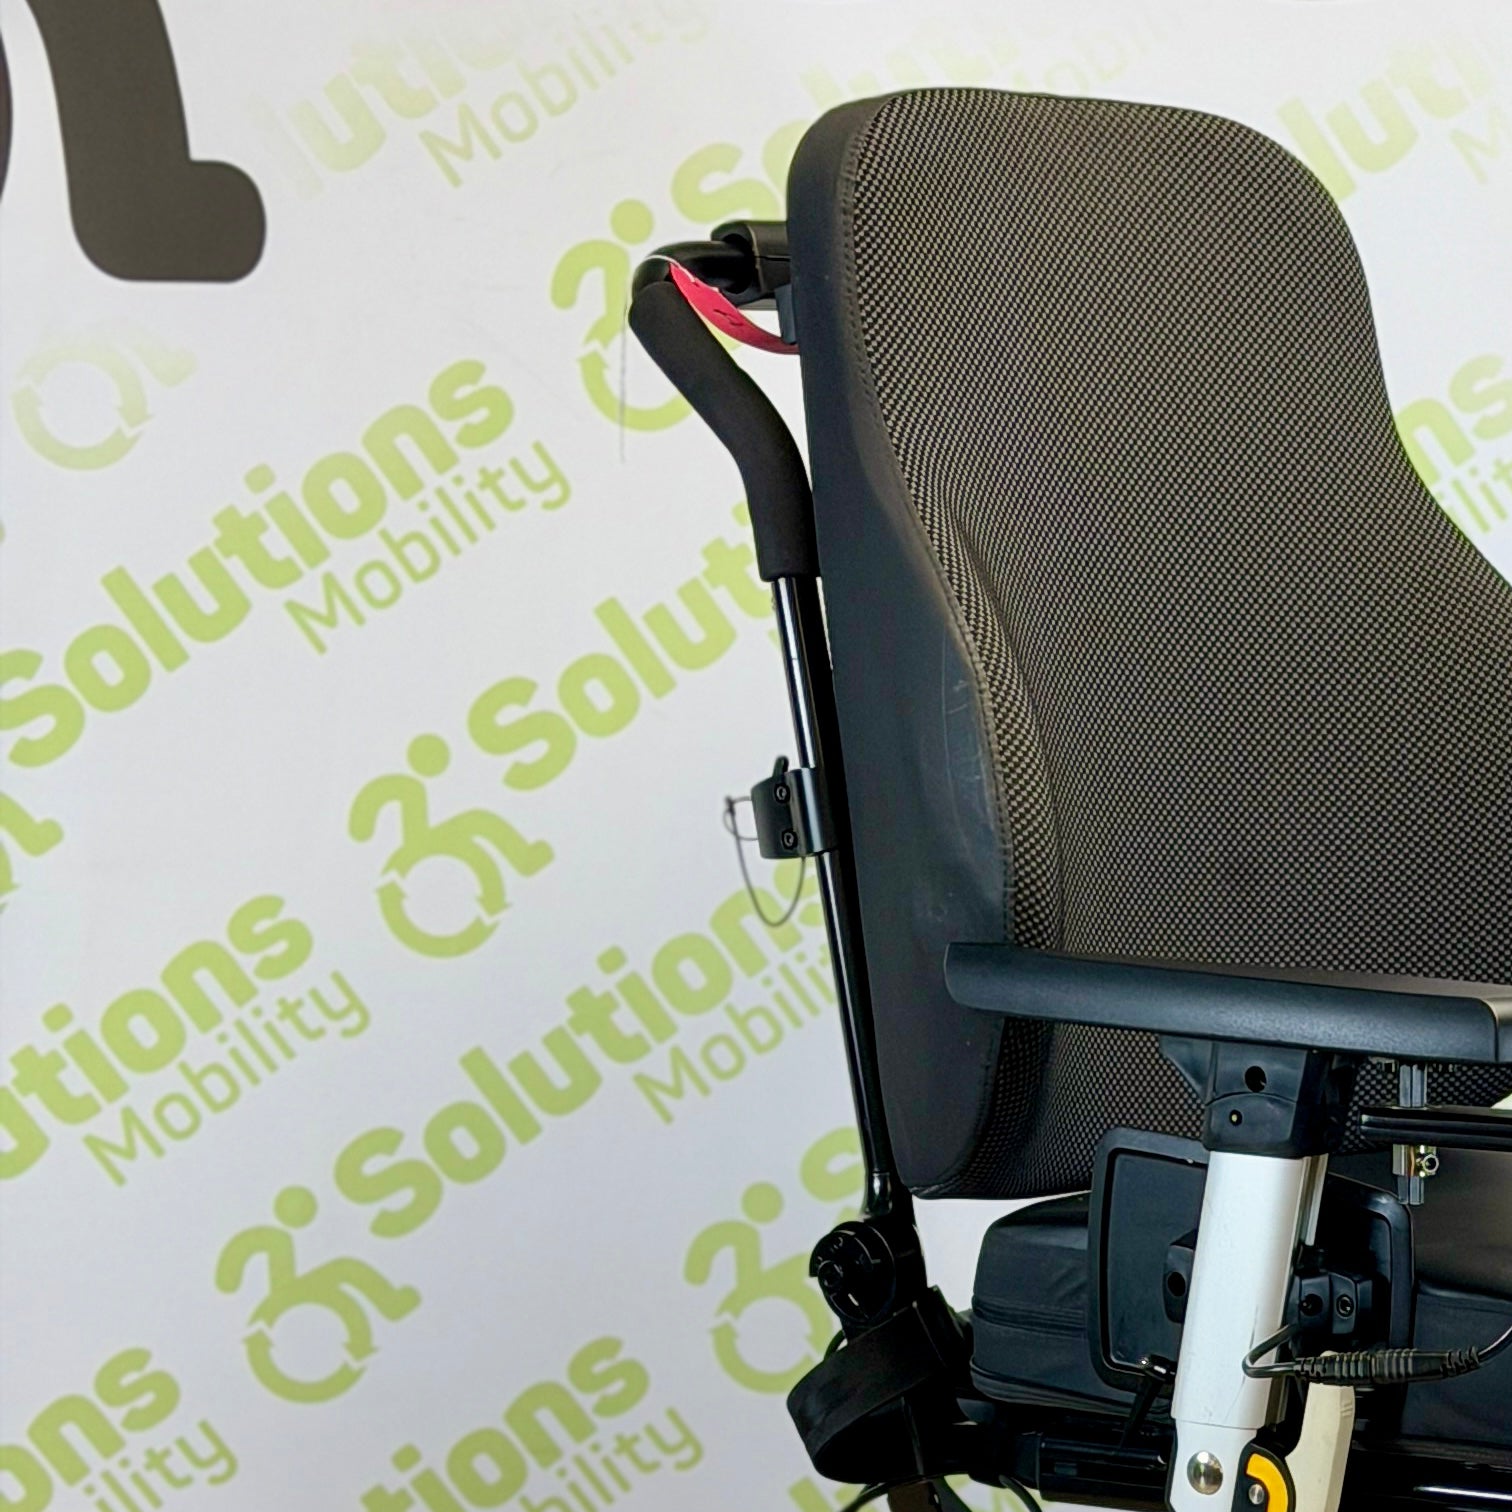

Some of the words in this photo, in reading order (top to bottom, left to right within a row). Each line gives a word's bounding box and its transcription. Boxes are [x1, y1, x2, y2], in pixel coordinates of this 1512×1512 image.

[0, 358, 516, 769] Solutions
[283, 440, 572, 656] Mobility
[466, 501, 776, 792] Solut
[0, 893, 315, 1182] utions
[82, 970, 370, 1187] Mobility
[632, 943, 836, 1125] Mobili
